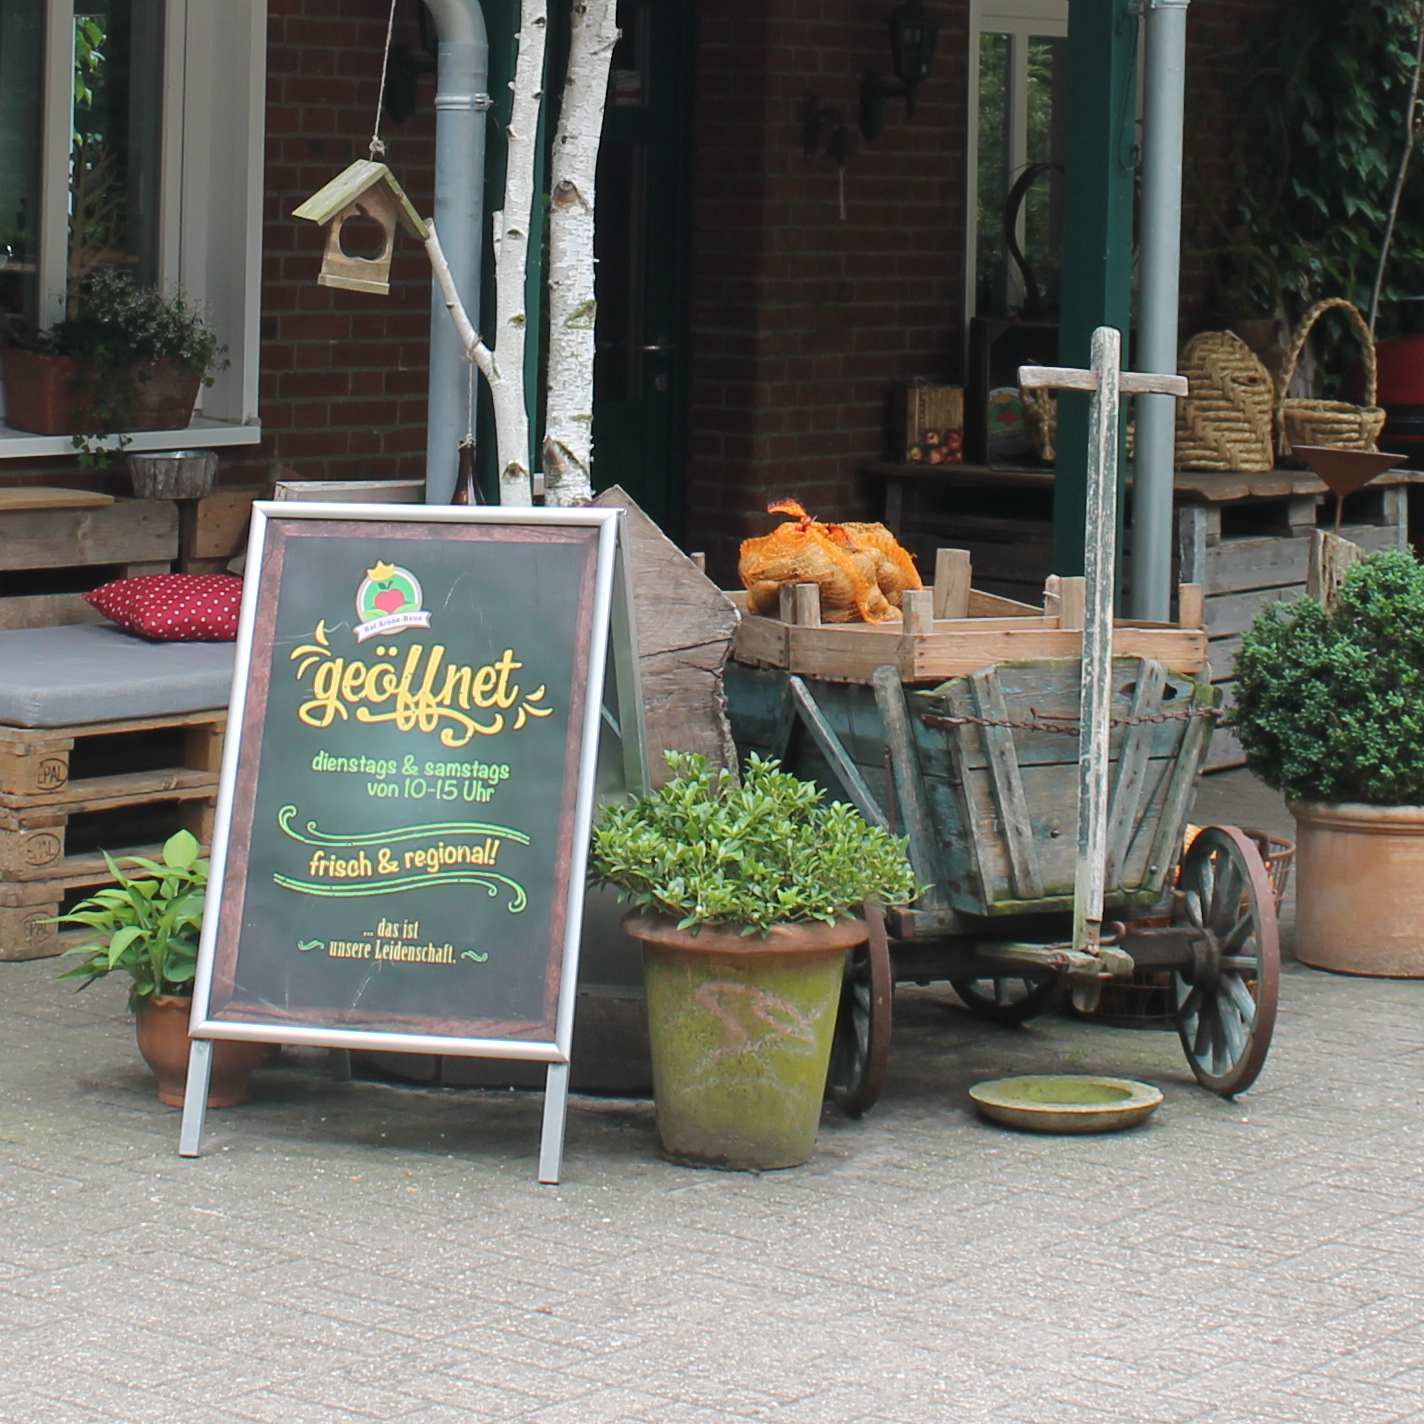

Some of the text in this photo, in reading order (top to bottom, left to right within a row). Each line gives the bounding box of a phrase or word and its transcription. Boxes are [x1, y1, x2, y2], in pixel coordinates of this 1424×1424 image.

[298, 644, 523, 747] geöffnet
[312, 750, 511, 785] dienstags & samstags
[367, 778, 495, 802] von 10-15 Uhr
[309, 837, 501, 878] frisch & regional!
[377, 917, 399, 938] das
[403, 919, 419, 939] ist
[329, 939, 457, 965] unsere Leidenschaft.
